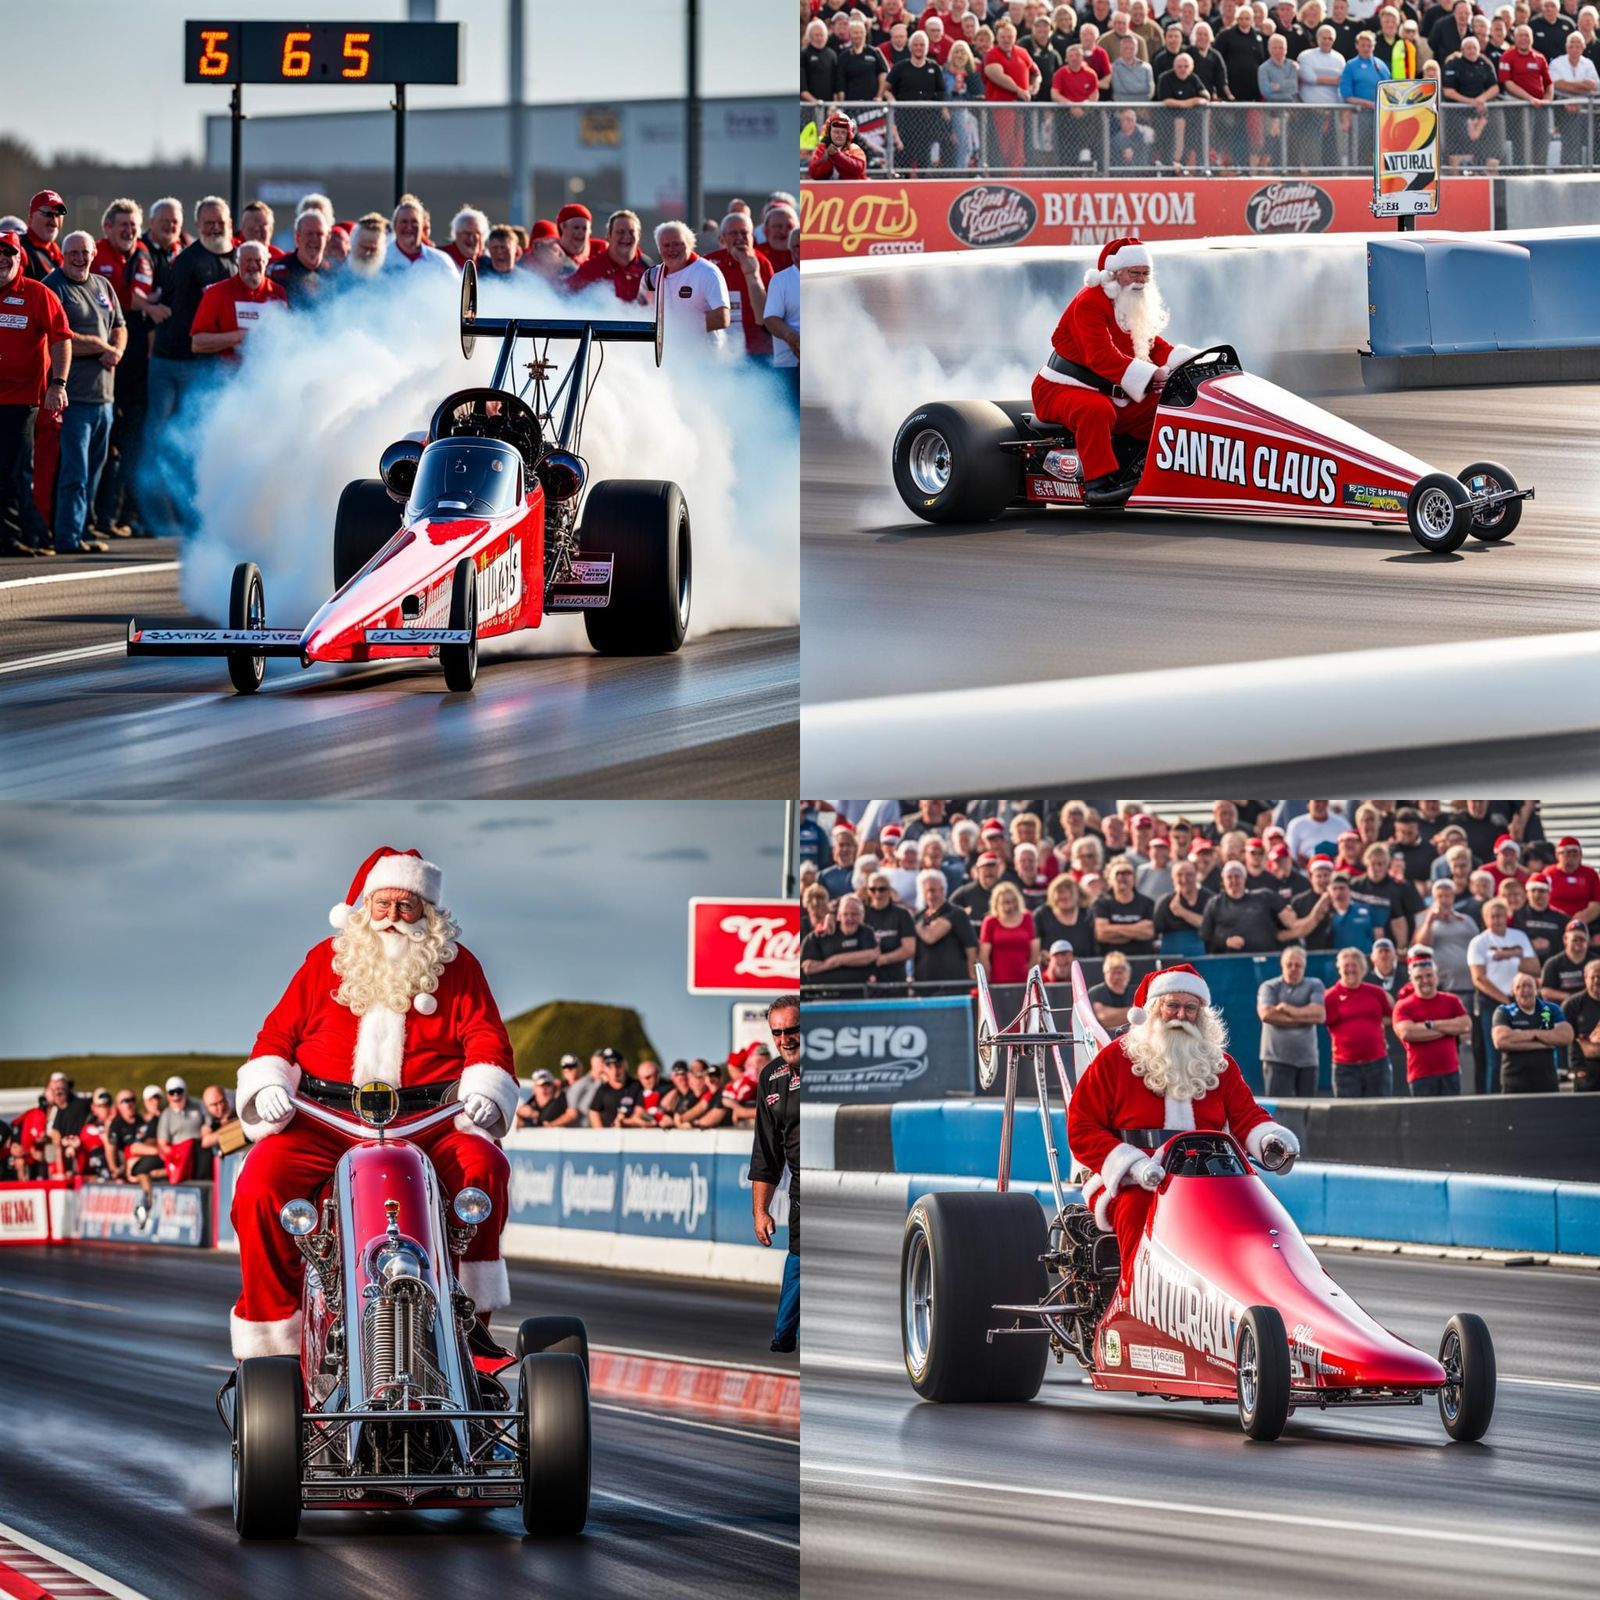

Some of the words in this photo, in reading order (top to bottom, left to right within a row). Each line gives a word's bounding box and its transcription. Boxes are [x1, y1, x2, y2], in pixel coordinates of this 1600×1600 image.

[282, 32, 311, 77] 6
[342, 33, 370, 78] 5
[1252, 445, 1338, 505] CLAUS
